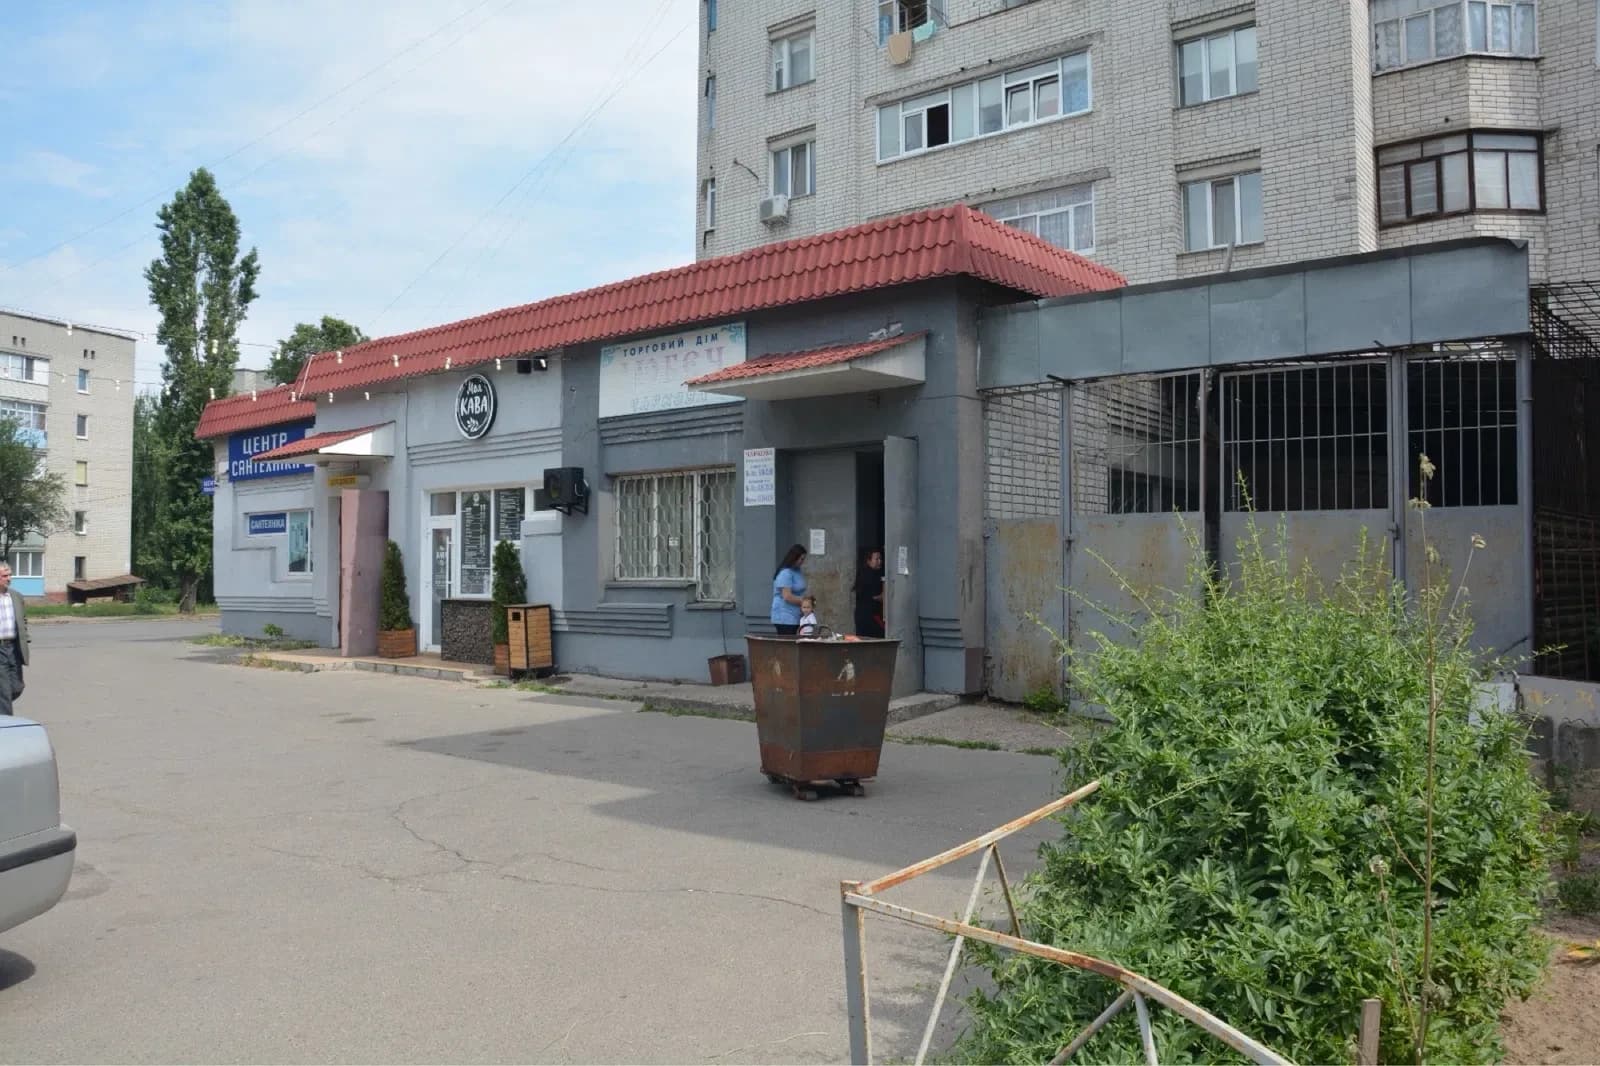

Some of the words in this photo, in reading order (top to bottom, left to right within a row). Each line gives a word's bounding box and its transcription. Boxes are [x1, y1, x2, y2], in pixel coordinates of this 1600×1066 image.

[623, 337, 685, 357] ТОРГОВИЙ
[696, 333, 718, 346] ДІМ
[460, 395, 488, 416] КАВА
[242, 432, 288, 455] ЦЕНТР
